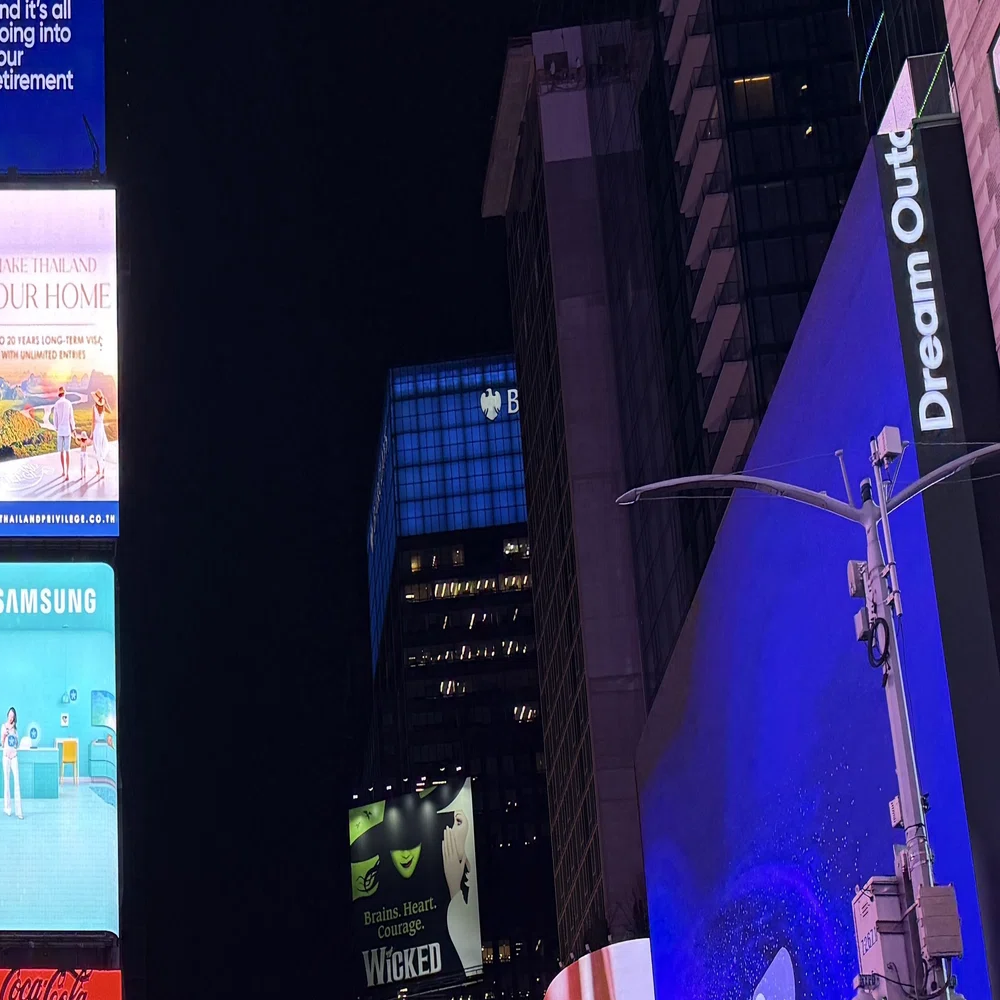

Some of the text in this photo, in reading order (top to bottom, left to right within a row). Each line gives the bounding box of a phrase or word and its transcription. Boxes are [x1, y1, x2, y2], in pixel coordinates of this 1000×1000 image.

[25, 0, 48, 20] it's
[52, 0, 72, 20] all
[39, 21, 72, 43] into
[32, 256, 97, 273] THAILAND
[45, 282, 111, 309] HOME
[6, 336, 16, 345] 20
[18, 336, 40, 345] YEARS
[41, 336, 84, 345] LONG-TERM
[907, 250, 954, 432] Dream
[1, 350, 86, 360] WITH UNLIMITED ENTRIES
[363, 897, 437, 926] Brains. Heart.
[377, 920, 425, 939] Courage.
